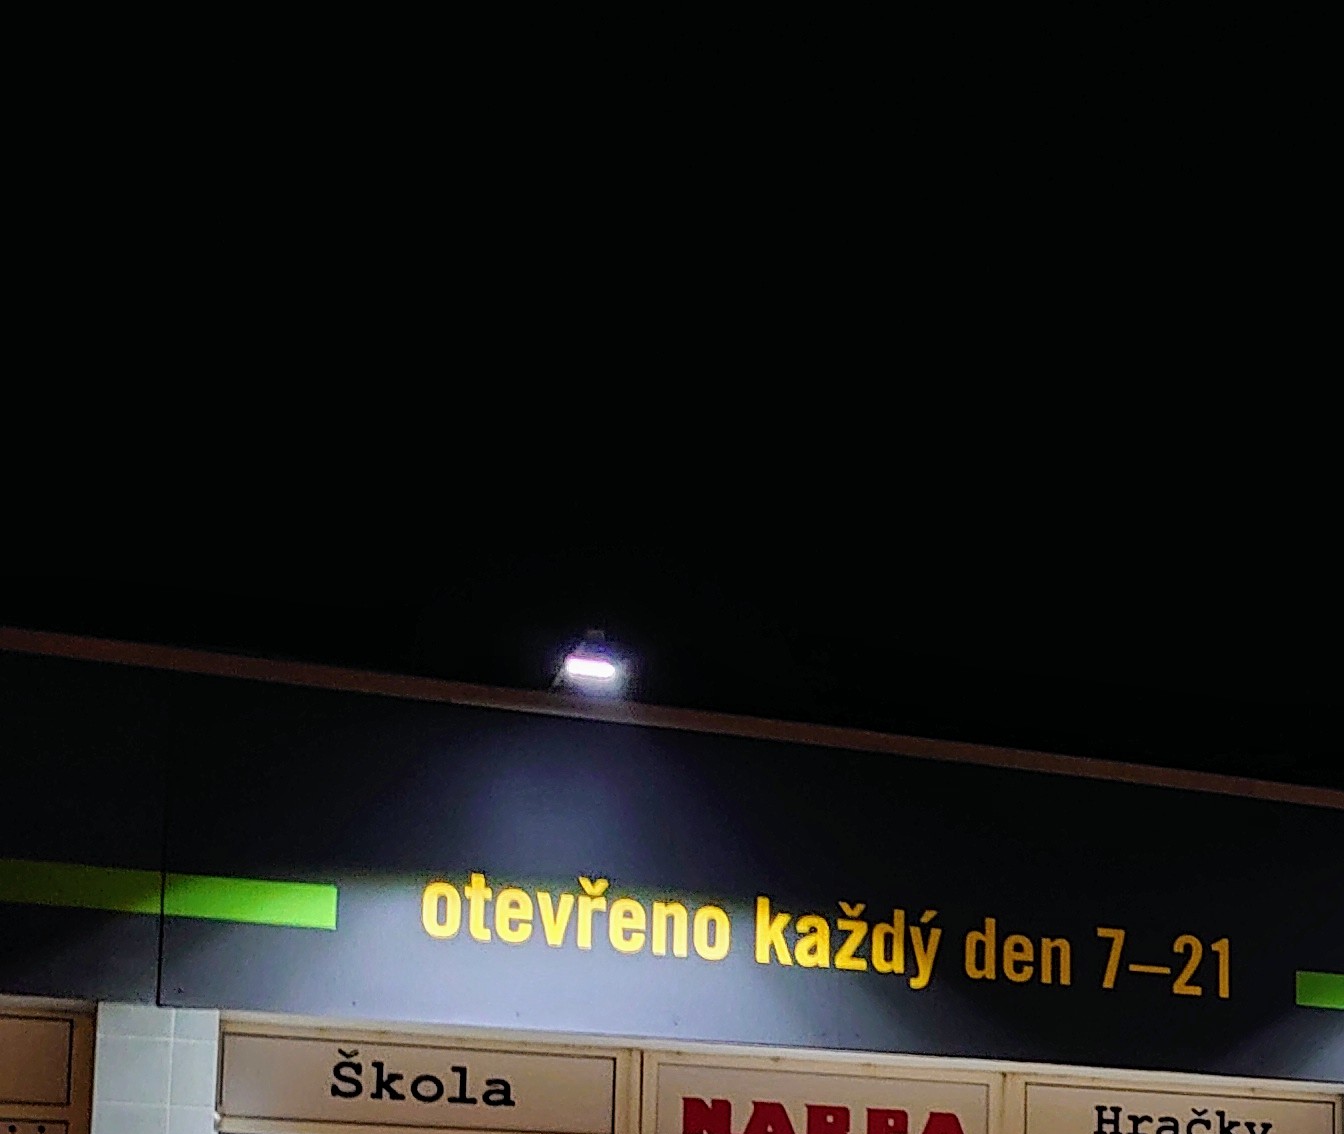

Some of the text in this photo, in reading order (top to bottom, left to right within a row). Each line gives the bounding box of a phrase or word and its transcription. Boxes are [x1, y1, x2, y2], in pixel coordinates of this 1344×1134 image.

[420, 872, 732, 961] otevřeno
[754, 896, 943, 991] každý
[964, 916, 1072, 986] den
[330, 1049, 516, 1107] Škola
